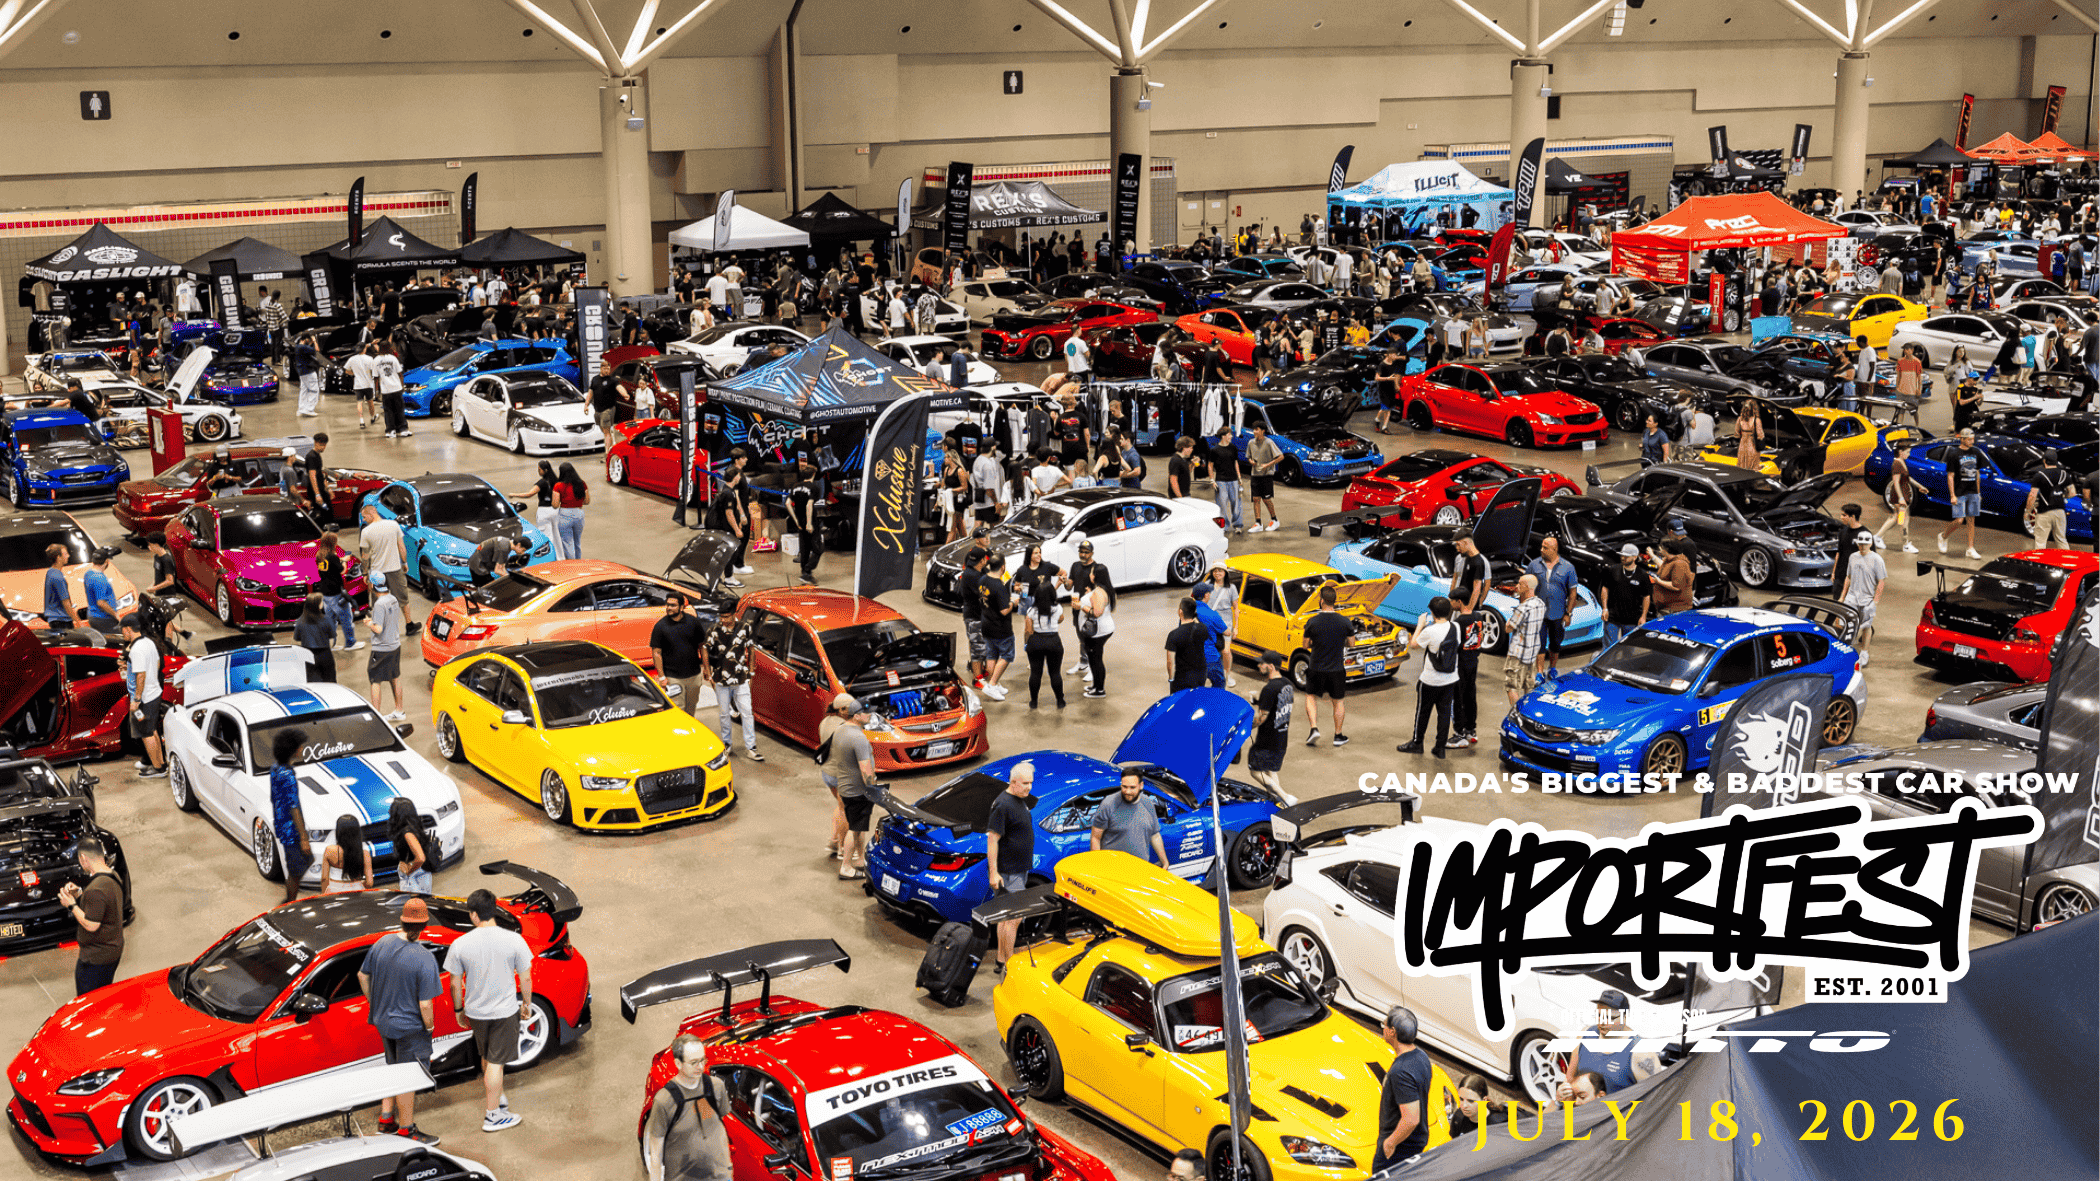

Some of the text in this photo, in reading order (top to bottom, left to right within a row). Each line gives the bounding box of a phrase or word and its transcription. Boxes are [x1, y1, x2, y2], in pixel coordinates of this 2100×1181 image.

[972, 192, 1049, 212] REX'S
[993, 204, 1044, 217] CUSTOMS
[980, 217, 1021, 229] CUSTOMS
[1036, 215, 1061, 225] REX'S
[1062, 213, 1100, 224] CUSTOMS
[57, 264, 183, 282] GASLIGHT
[809, 405, 877, 420] @GHOSTAUTOMOTIVE
[872, 446, 908, 554] Xclusive
[1657, 633, 1699, 649] SUBARU
[1773, 634, 1787, 658] 5
[1770, 656, 1793, 669] Solberg
[588, 706, 637, 726] Xclusive
[1700, 709, 1708, 725] 5
[302, 740, 355, 763] Xclusive
[826, 1065, 958, 1110] TOYO TIRES
